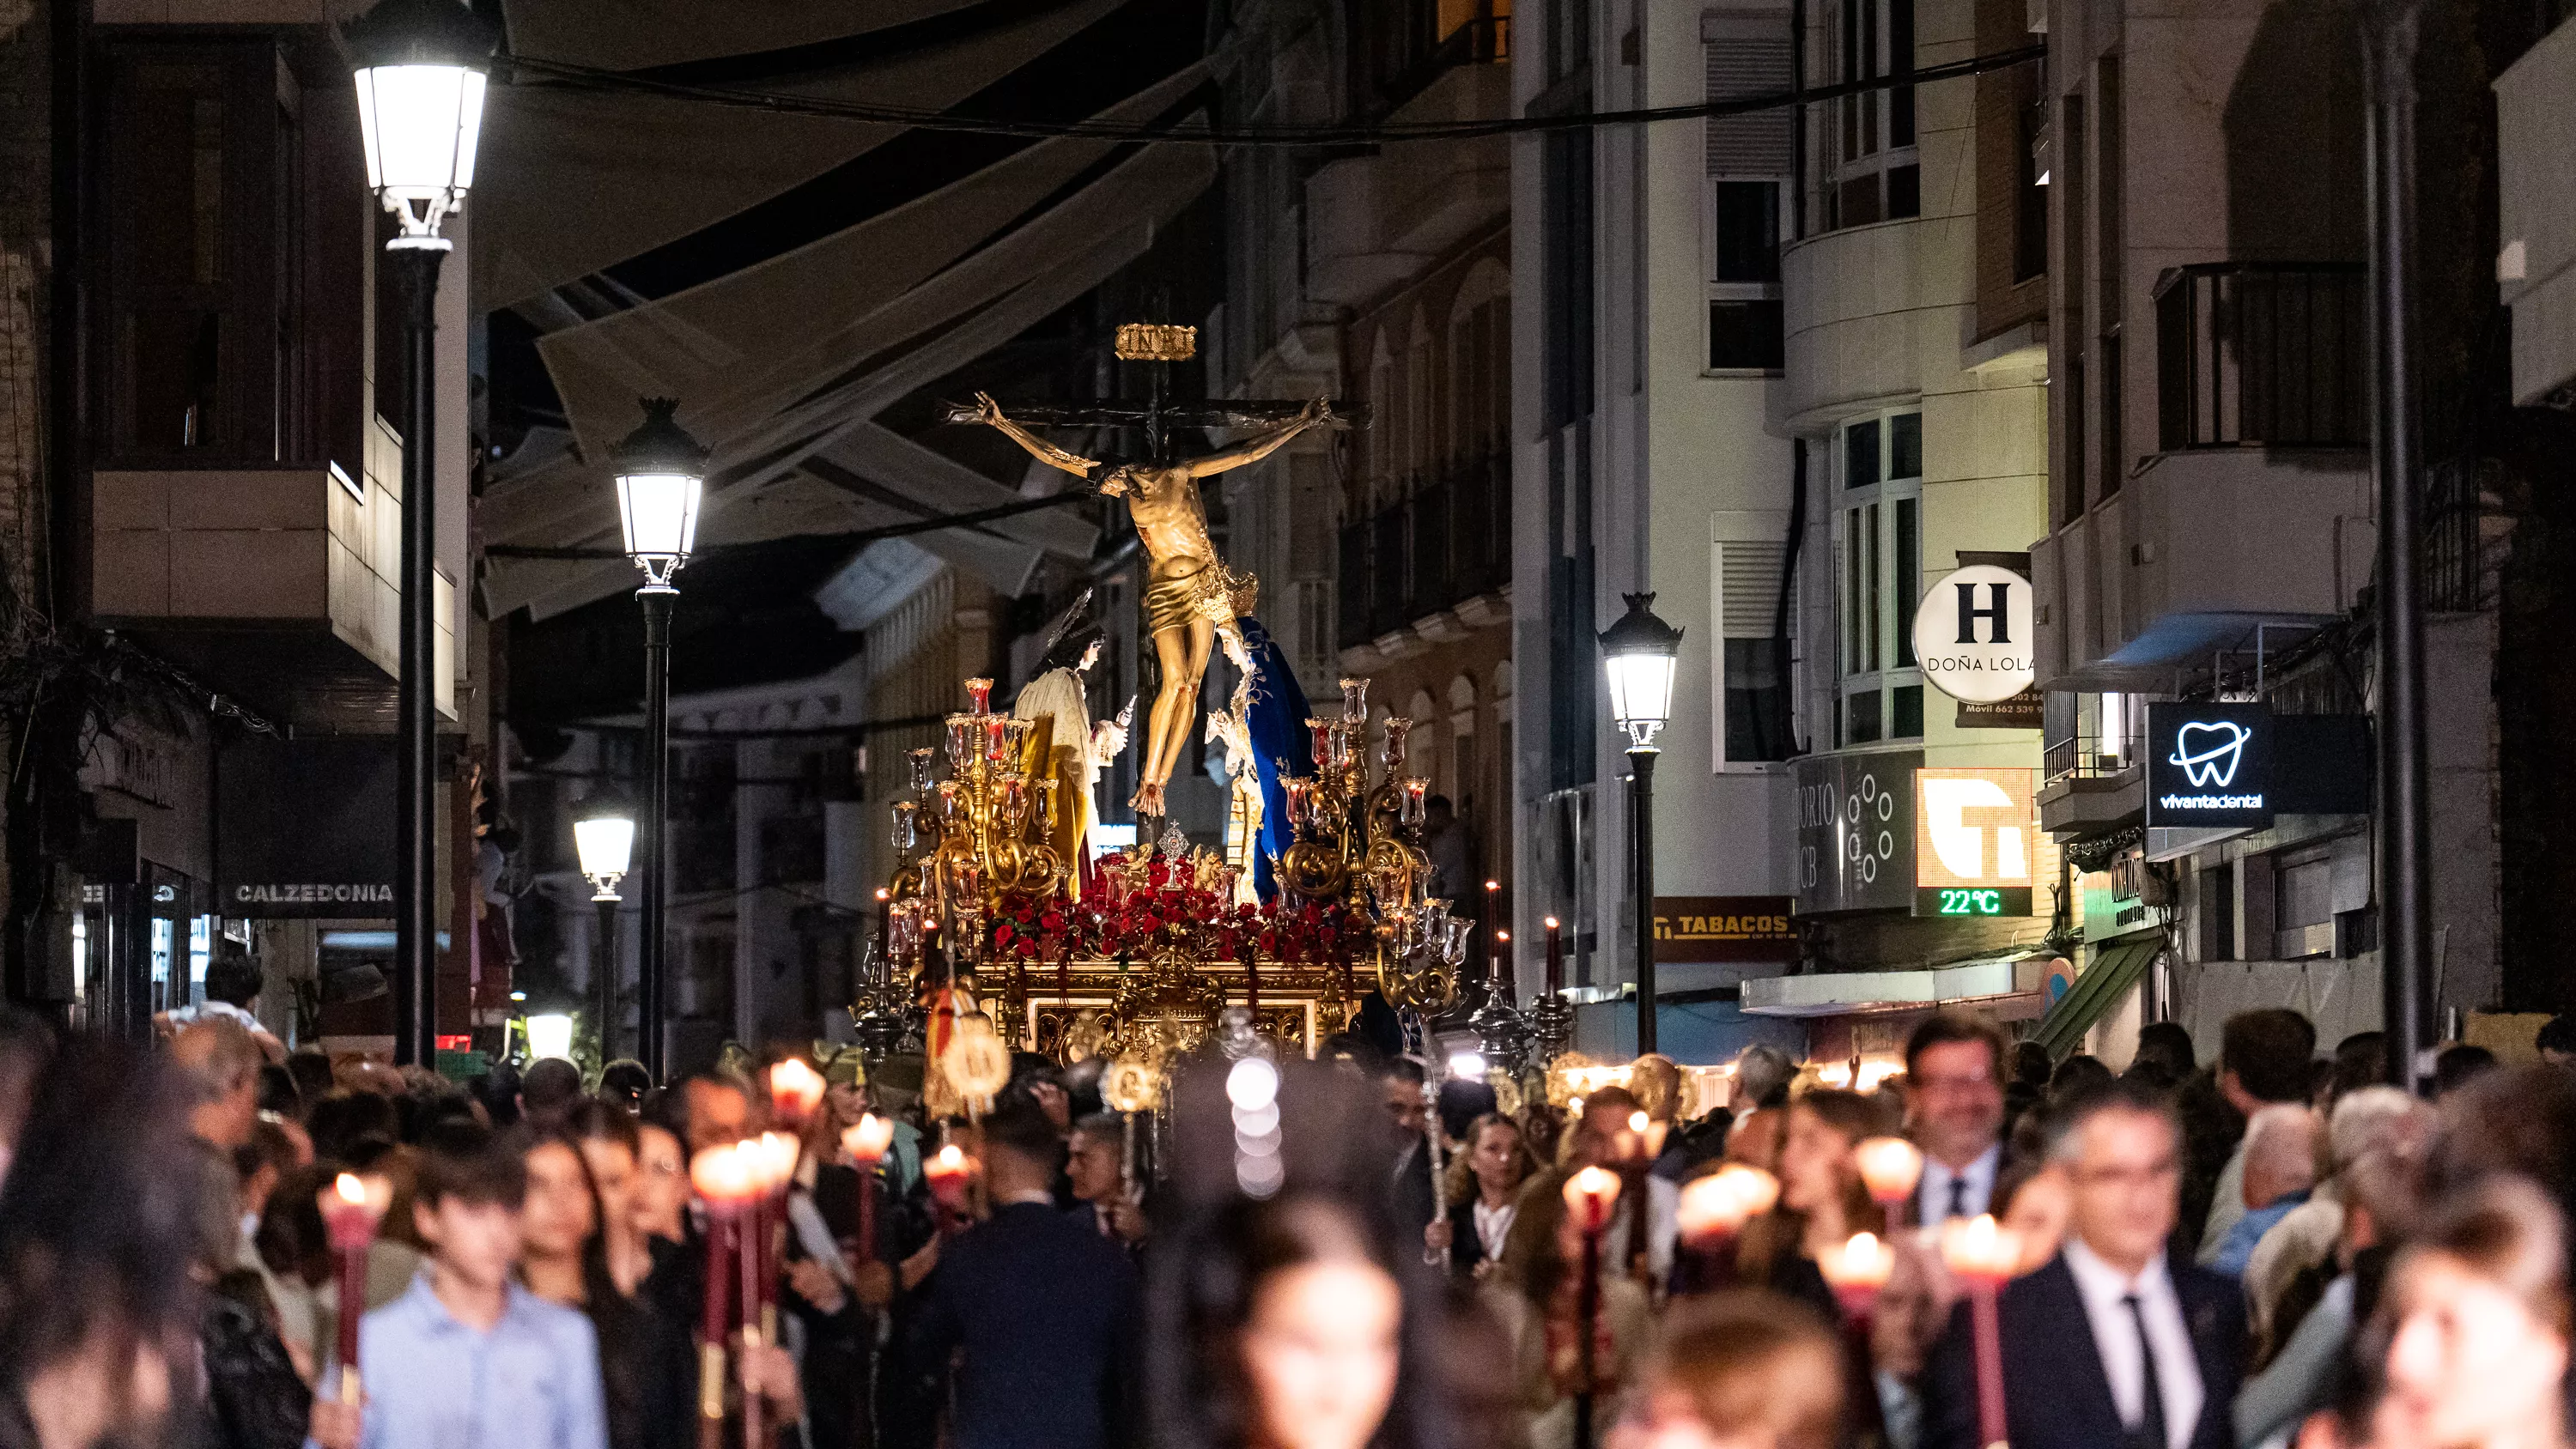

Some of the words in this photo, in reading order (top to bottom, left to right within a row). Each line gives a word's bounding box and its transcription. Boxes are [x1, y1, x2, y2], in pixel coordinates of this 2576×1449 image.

[1126, 327, 1189, 354] INRI
[1954, 583, 2012, 644] H
[1928, 655, 1984, 671] DOÑA
[1965, 705, 1993, 713] Móvil
[1995, 705, 2014, 713] 662
[2016, 706, 2034, 714] 539
[2160, 793, 2263, 809] vivantadental
[235, 884, 394, 902] CALZEDONIA
[1679, 916, 1789, 933] TABACOS
